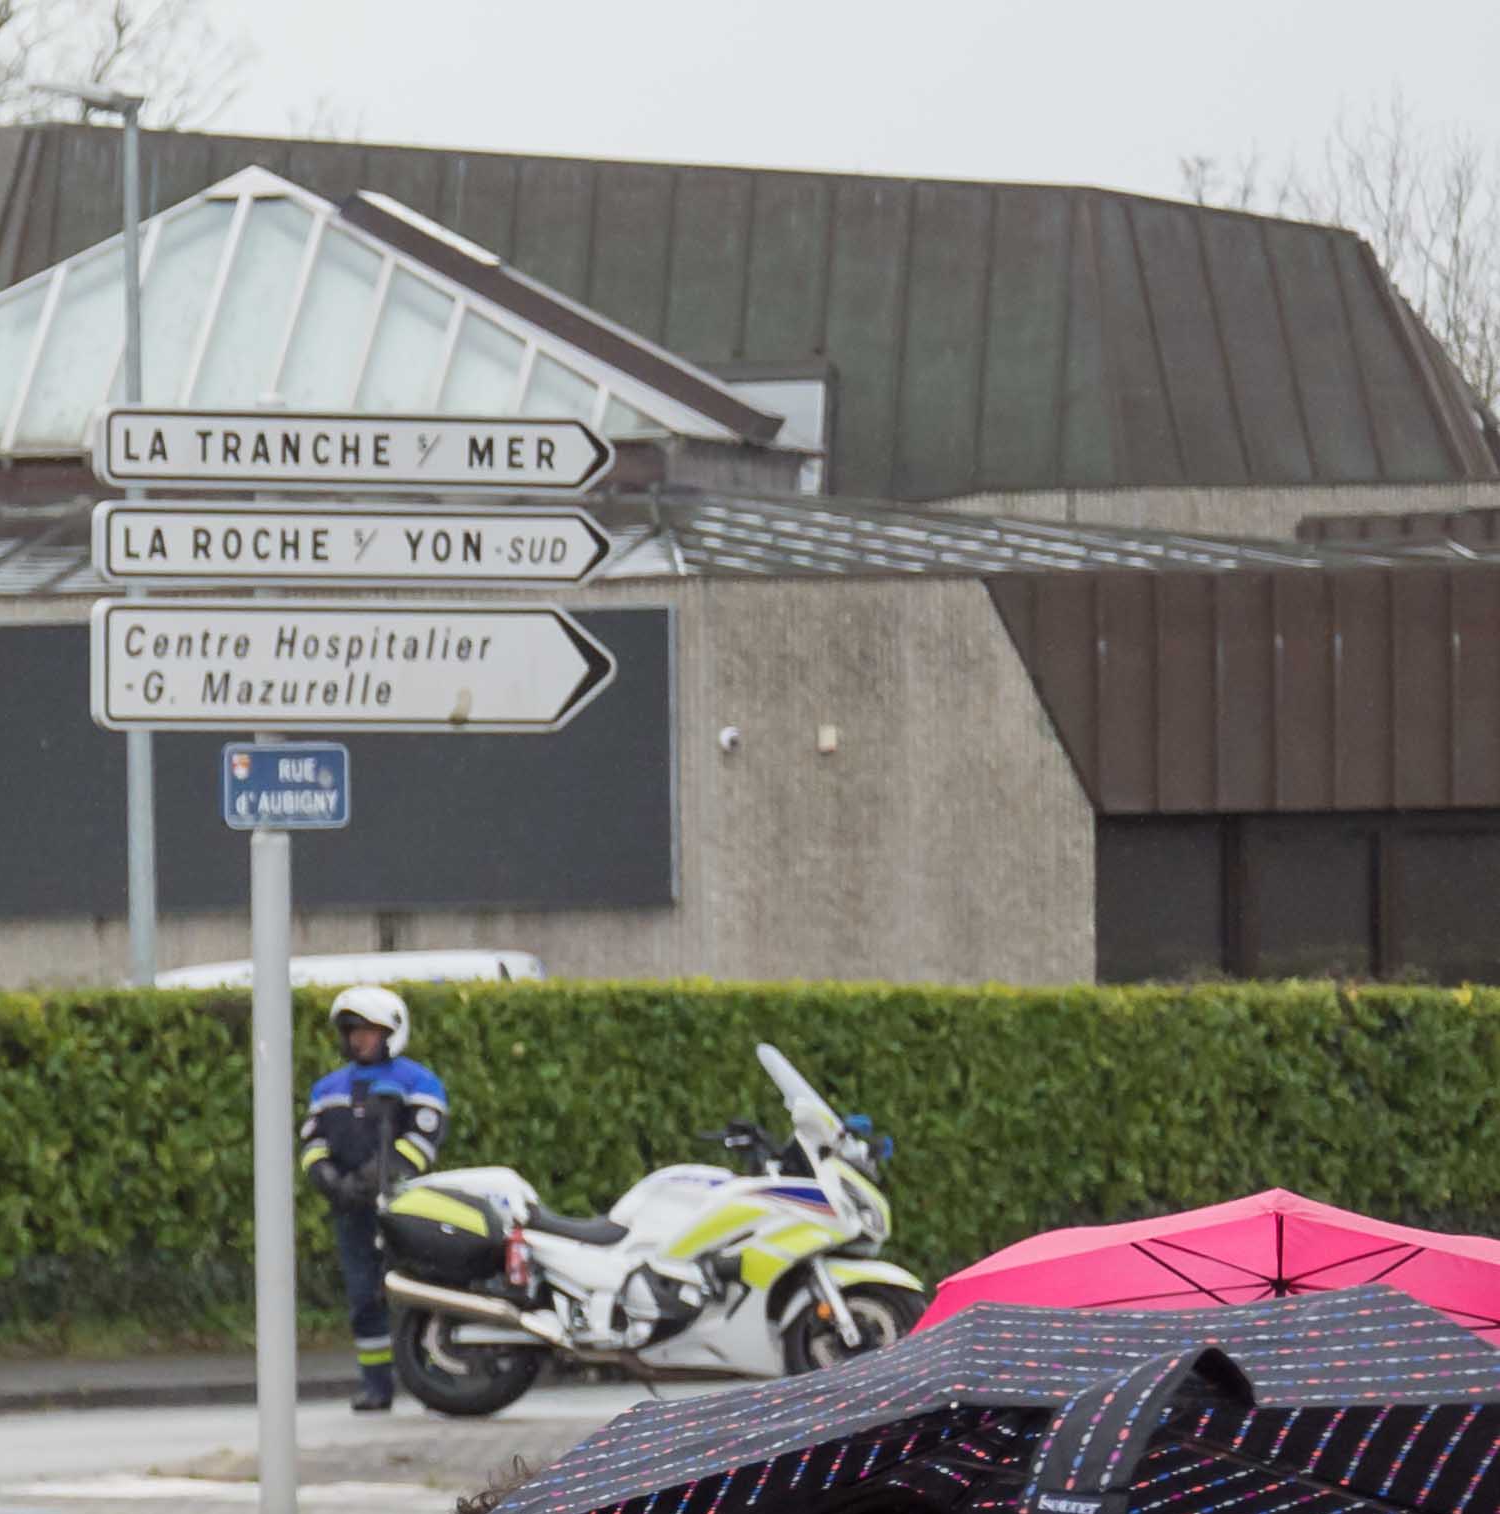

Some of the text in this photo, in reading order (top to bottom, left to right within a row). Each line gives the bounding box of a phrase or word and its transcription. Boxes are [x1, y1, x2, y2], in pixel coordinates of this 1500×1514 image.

[122, 430, 169, 462] LA
[196, 431, 392, 468] TRANCHE
[467, 436, 557, 471] MER
[122, 526, 169, 560] LA
[192, 527, 330, 562] ROCHE
[124, 625, 493, 668] Centre Hospitalier
[201, 669, 393, 705] Mazurelle
[278, 757, 317, 784] RUE
